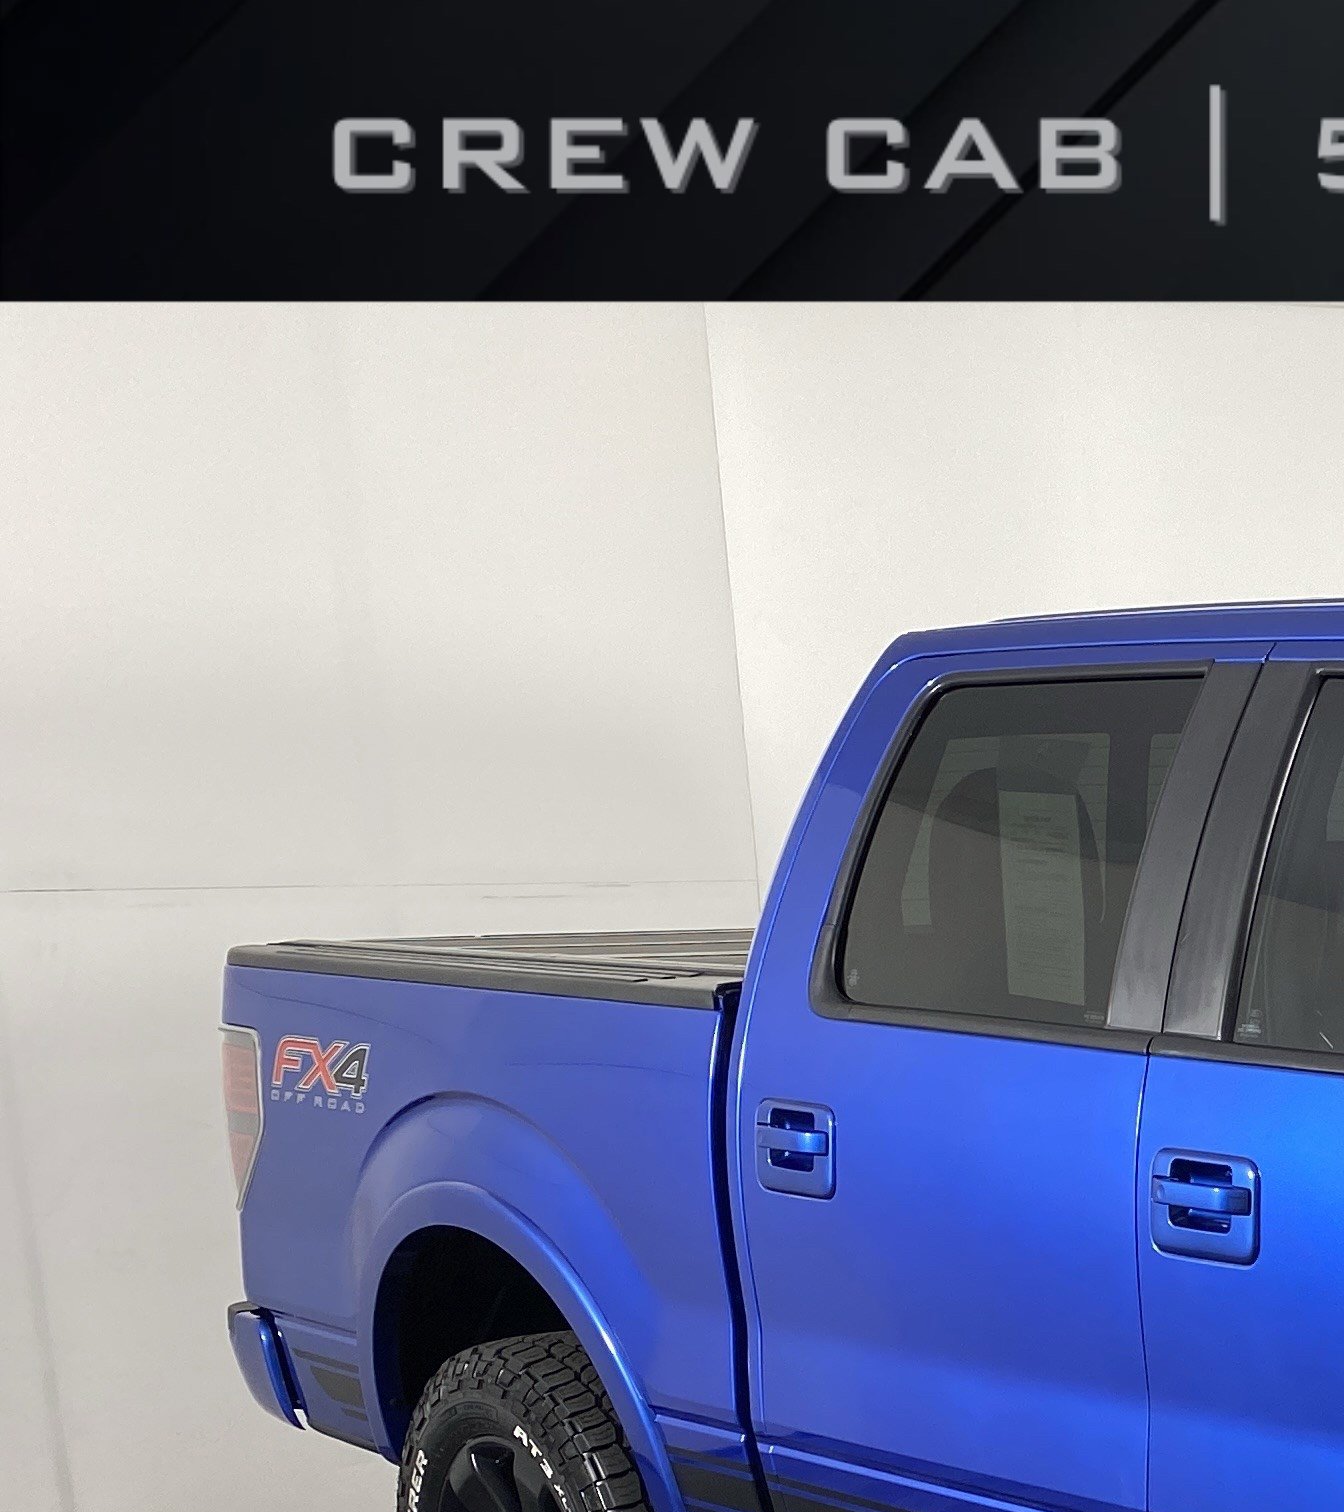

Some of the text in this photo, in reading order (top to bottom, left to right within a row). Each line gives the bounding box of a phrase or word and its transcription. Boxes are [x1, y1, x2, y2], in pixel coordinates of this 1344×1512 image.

[270, 1034, 371, 1100] FX4
[270, 1088, 366, 1115] OFF ROAD
[513, 1424, 554, 1480] AT3
